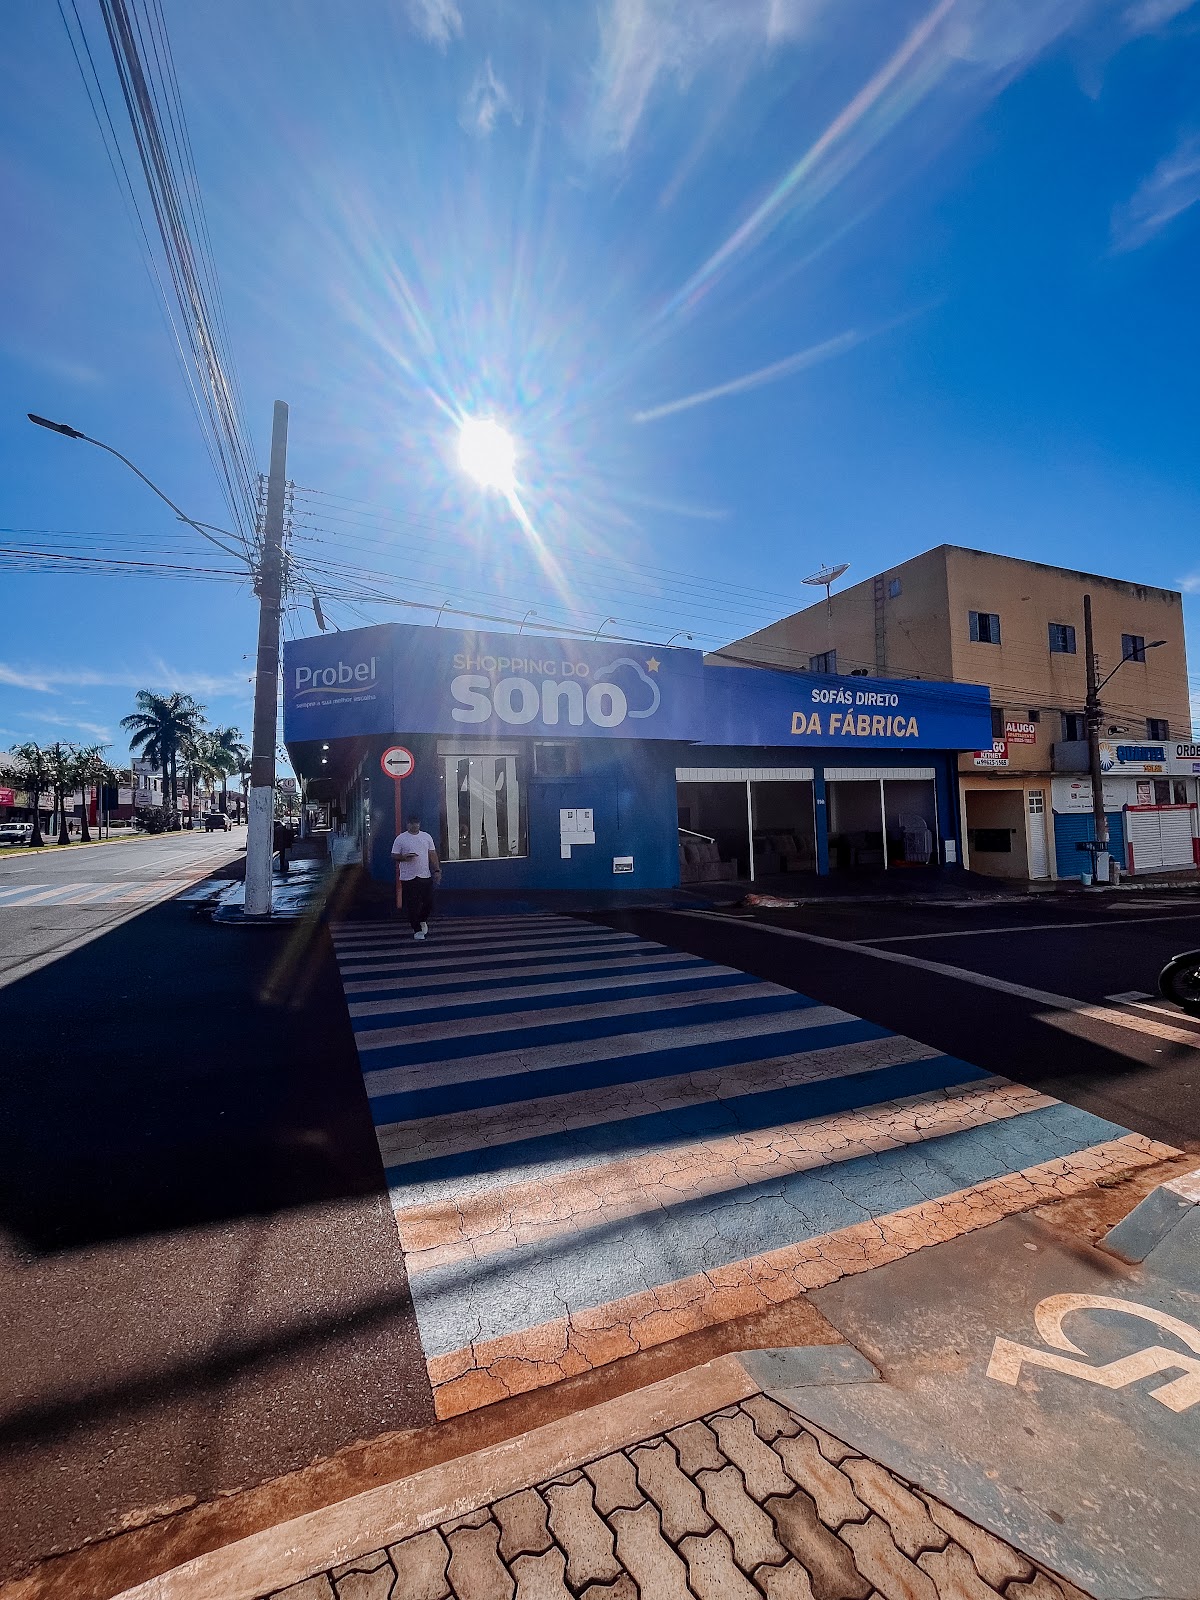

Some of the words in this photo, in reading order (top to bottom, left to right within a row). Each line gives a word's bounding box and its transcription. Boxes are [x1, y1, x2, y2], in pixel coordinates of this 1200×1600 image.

[296, 657, 375, 689] Probel
[453, 654, 556, 675] SHOPPING
[562, 662, 589, 677] DO
[451, 675, 627, 727] sono
[811, 687, 852, 704] SOFÁS
[856, 692, 898, 706] DIRETO
[791, 712, 821, 735] DA
[829, 708, 919, 737] FÁBRICA
[1006, 722, 1035, 733] ALUGO
